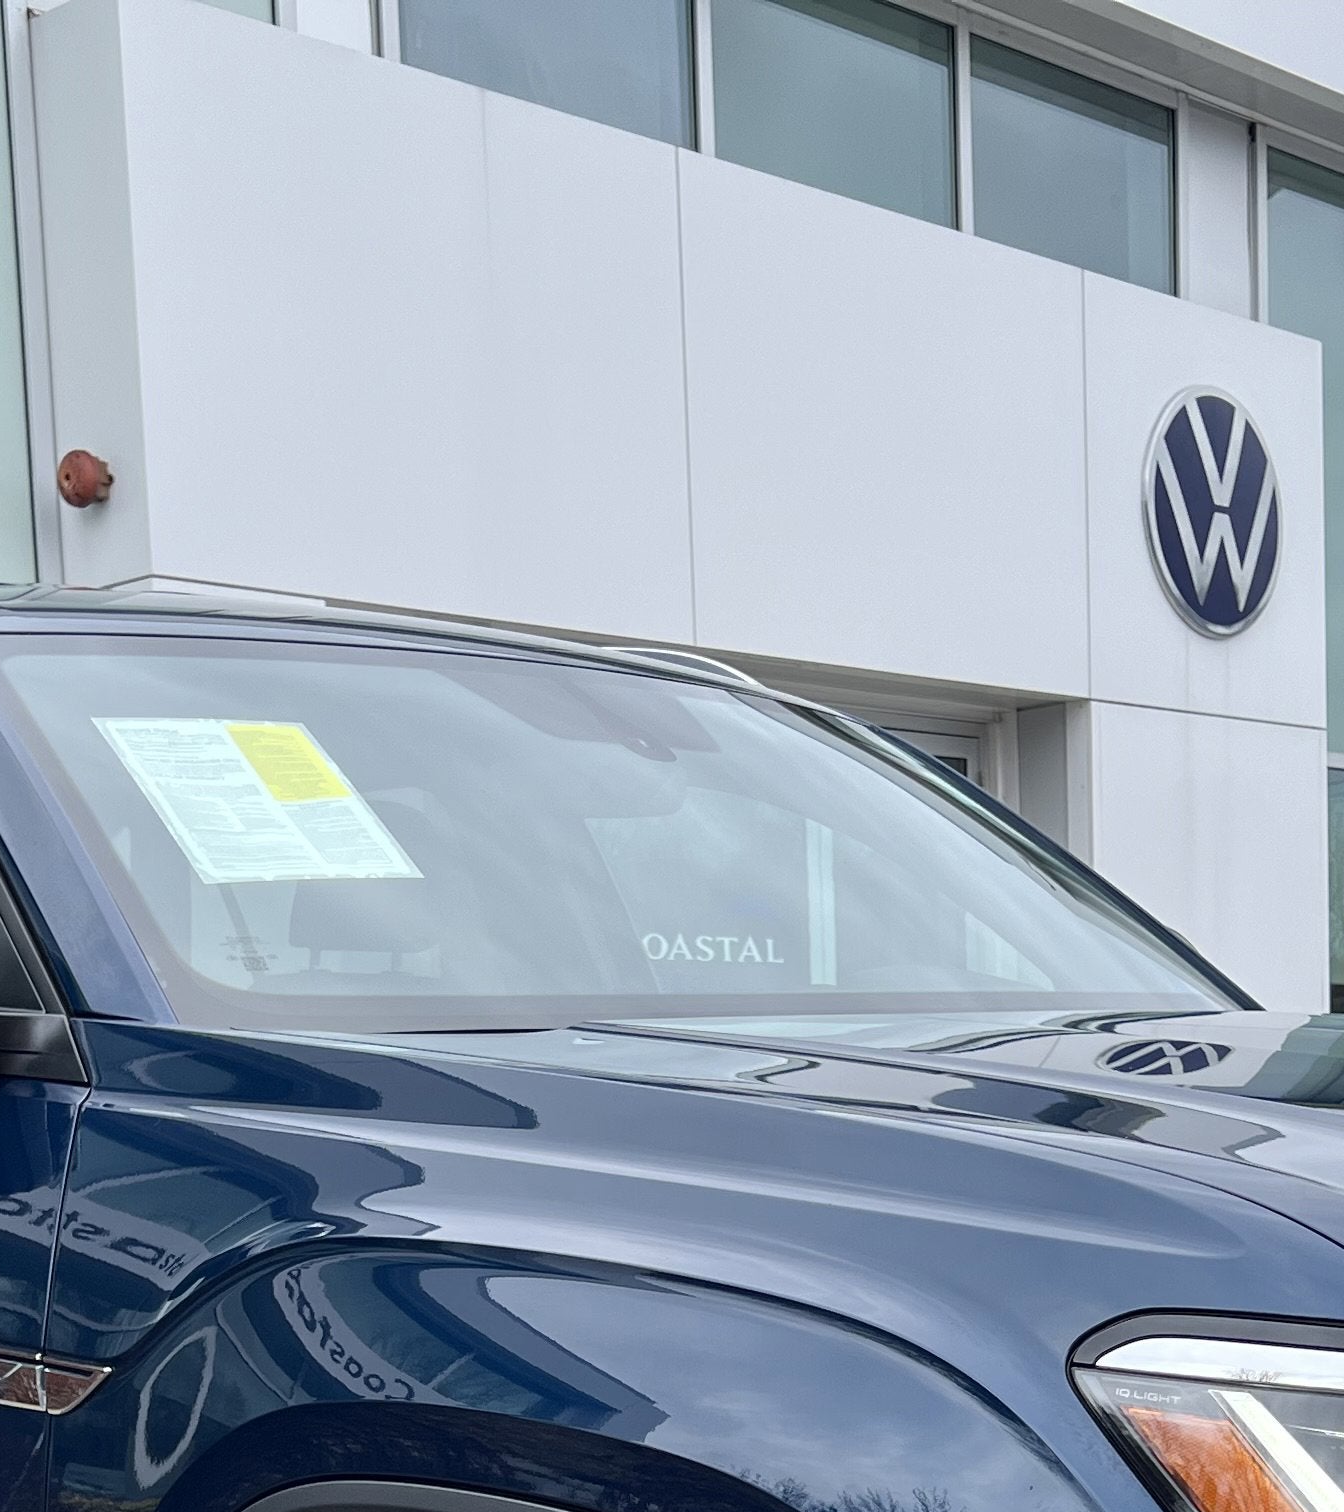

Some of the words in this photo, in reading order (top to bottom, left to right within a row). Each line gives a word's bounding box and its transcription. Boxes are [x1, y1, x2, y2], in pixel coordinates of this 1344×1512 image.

[1146, 387, 1281, 630] VW
[641, 932, 785, 964] OASTAL
[1115, 1387, 1182, 1405] IQ.LIGHT
